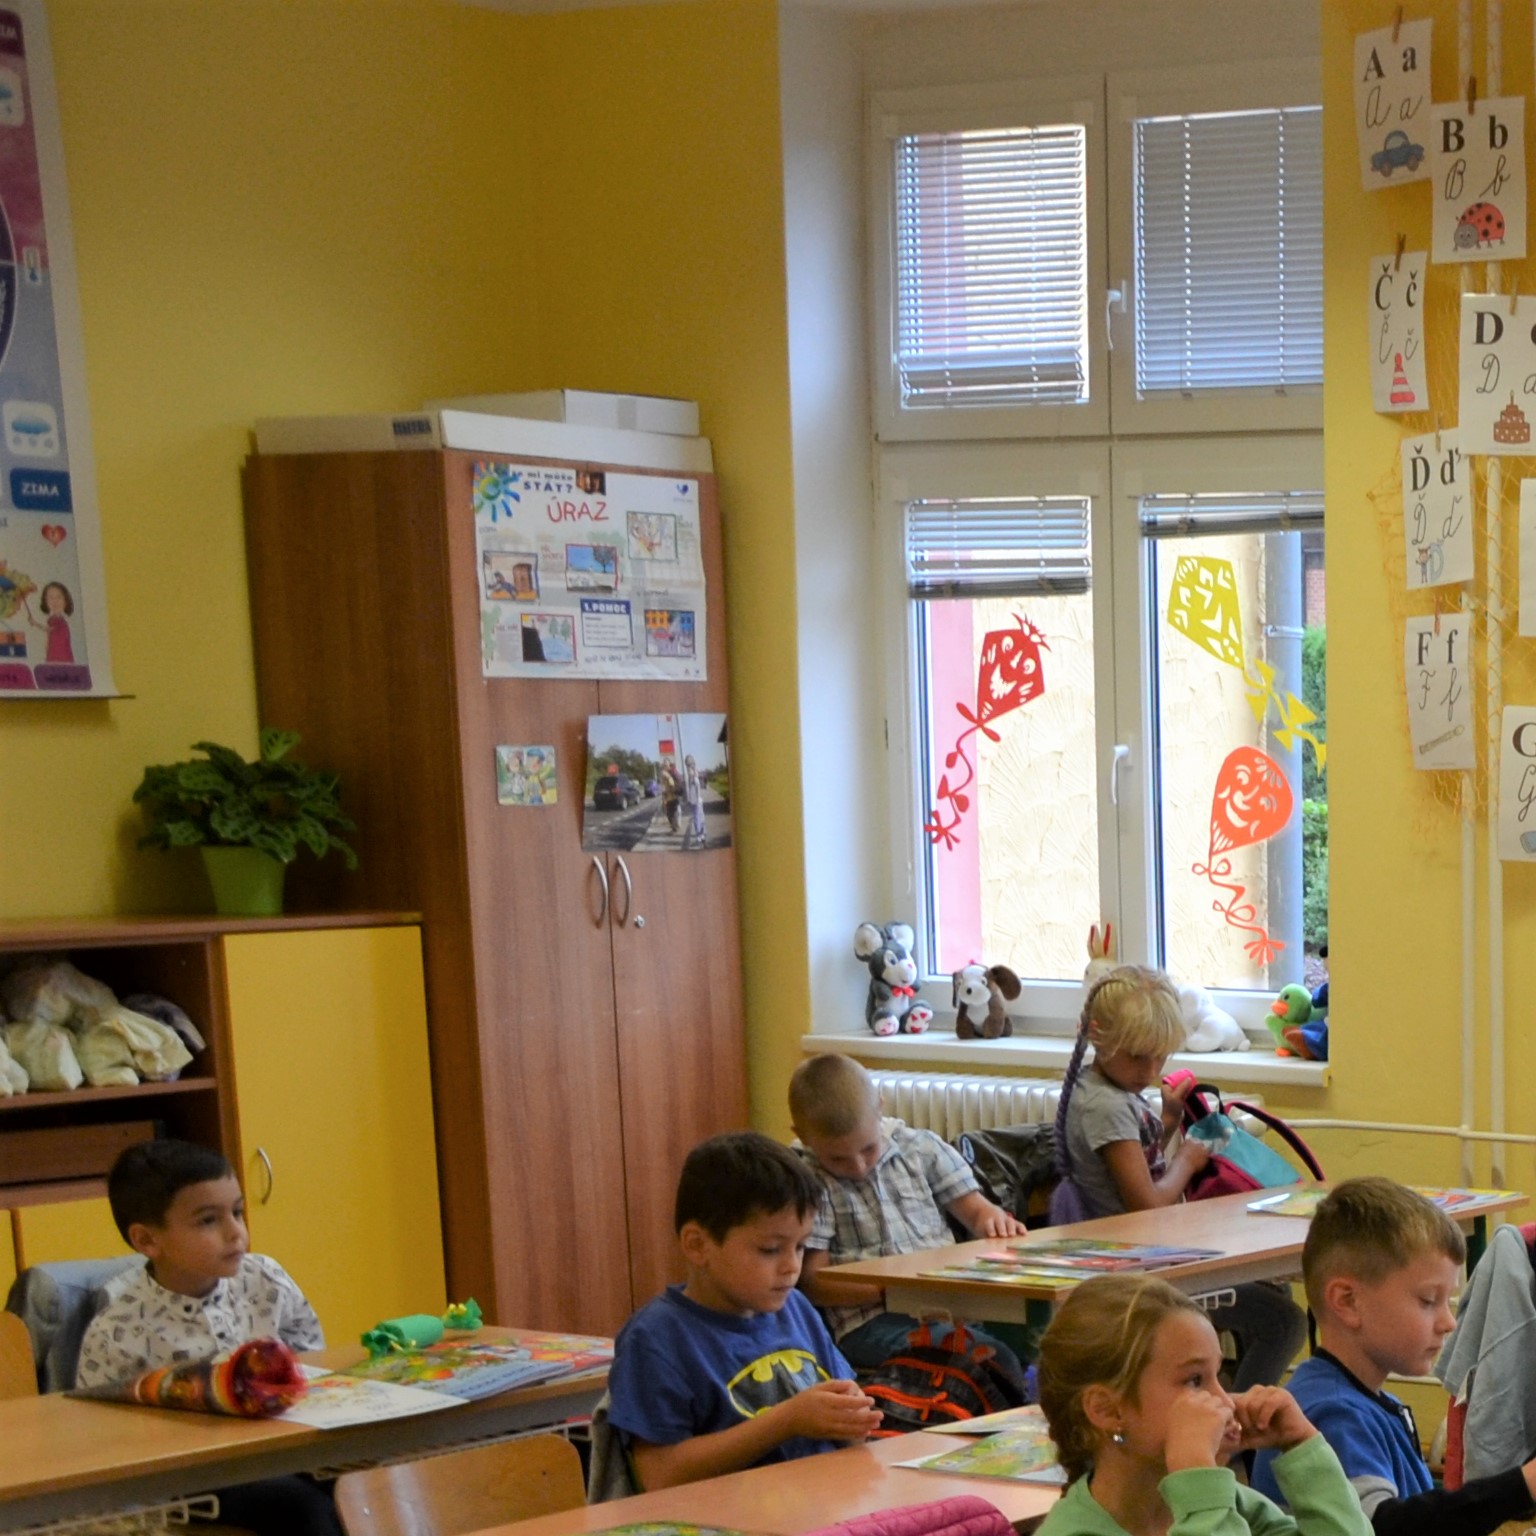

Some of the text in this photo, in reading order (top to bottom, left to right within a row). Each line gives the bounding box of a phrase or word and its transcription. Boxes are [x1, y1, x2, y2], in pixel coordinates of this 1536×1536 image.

[1363, 47, 1416, 82] A a
[1442, 115, 1509, 153] B b
[1375, 263, 1418, 311] Č č
[1473, 311, 1504, 345] D
[1410, 445, 1462, 492] Ď ď
[21, 481, 60, 497] ZIMA
[547, 495, 609, 523] ÚRAZ
[1417, 629, 1458, 666] F f
